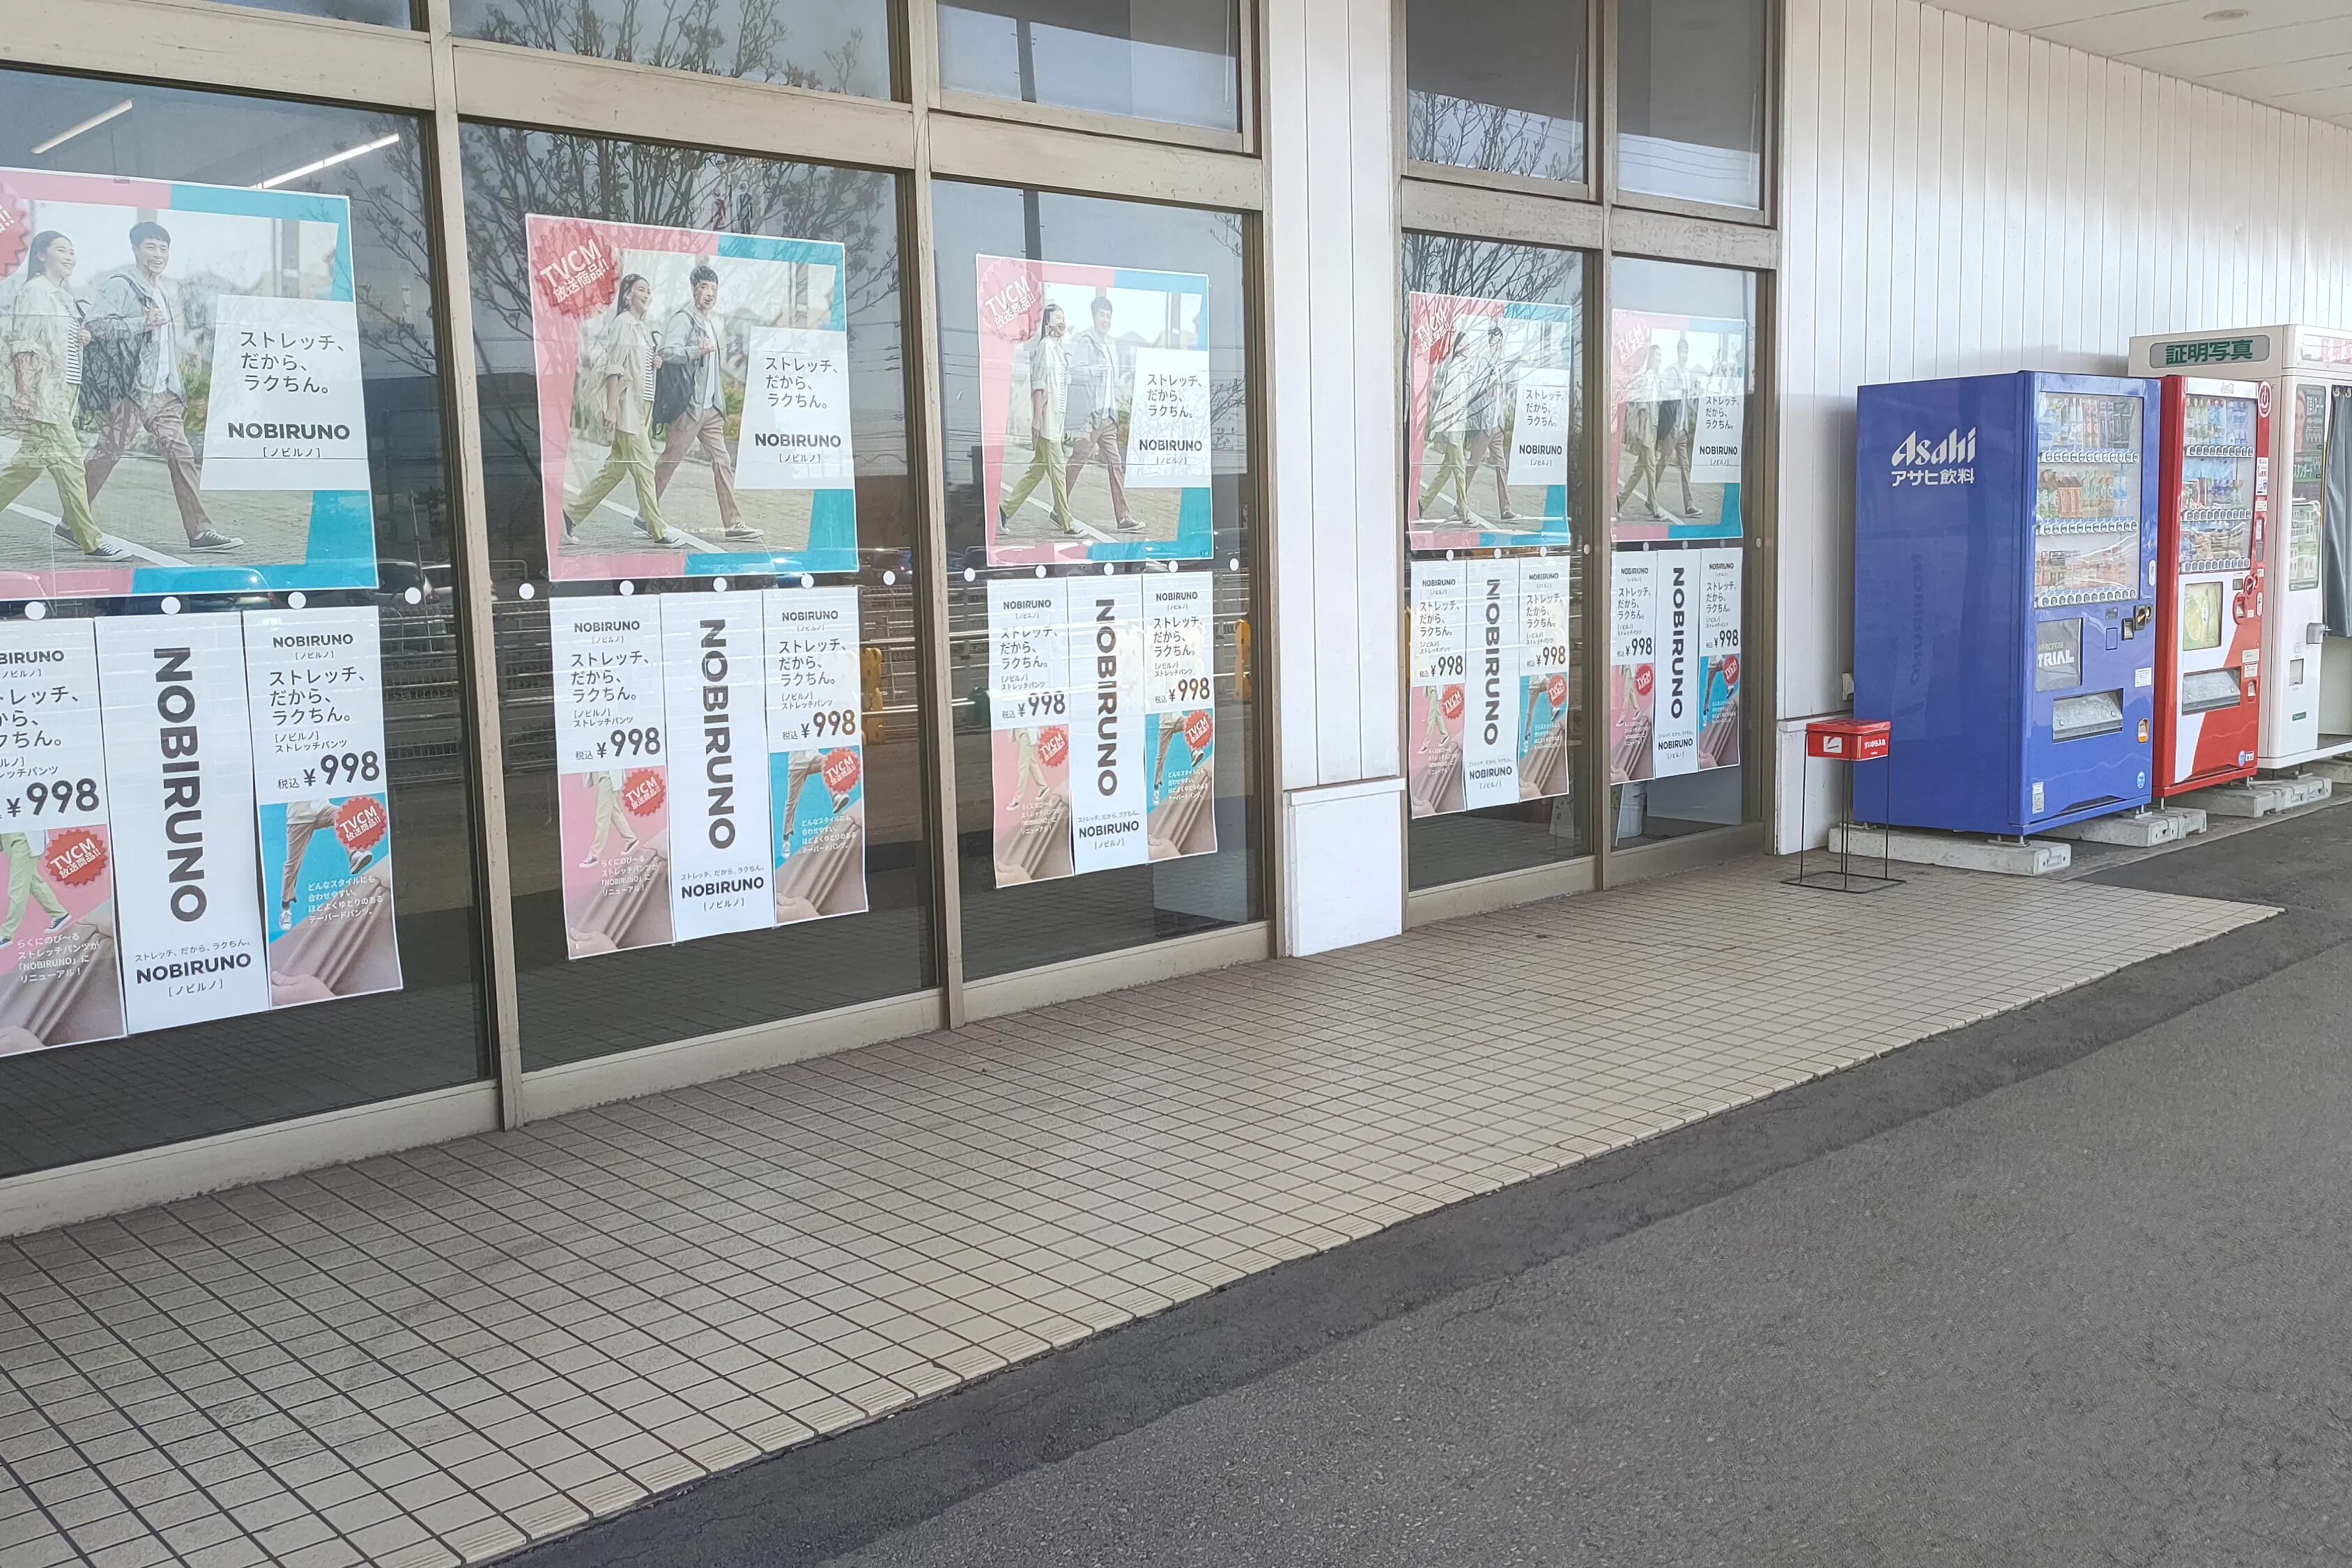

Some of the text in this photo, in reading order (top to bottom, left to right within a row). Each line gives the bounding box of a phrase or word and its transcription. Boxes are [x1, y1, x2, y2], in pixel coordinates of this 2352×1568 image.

[540, 239, 601, 287] TVCM
[985, 275, 1031, 316] TVCM
[241, 332, 344, 351] ストレッチ、
[2166, 339, 2252, 364] 証明写真
[241, 353, 307, 371] だから、
[766, 357, 838, 373] ストレッチ、
[245, 375, 328, 394] ラクちん。
[766, 375, 812, 390] だから、
[1148, 374, 1201, 387] ストレッチ、
[768, 393, 827, 409] ラクちん。
[1148, 389, 1182, 402] だから、
[1148, 405, 1192, 418] ラクちん。
[1526, 402, 1551, 413] だから、
[1706, 408, 1727, 417] だから、
[1528, 415, 1557, 427] ラクちん。
[1706, 420, 1733, 429] ラクちん。
[228, 423, 350, 440] NOBIRUNO
[755, 433, 840, 447] NOBIRUNO
[1139, 439, 1202, 451] NOBIRUNO
[1519, 445, 1562, 455] NOBIRUNO
[1700, 446, 1737, 455] NOBIRUNO
[1891, 426, 1976, 466] Asahi
[1891, 468, 1974, 486] アサヒ飲料
[1422, 579, 1455, 587] NOBIRUNO
[1004, 599, 1051, 610] NOBIRUNO
[1156, 592, 1198, 601] NOBIRUNO
[1420, 600, 1459, 611] ストレッチ、
[782, 610, 838, 622] NOBIRUNO
[1153, 616, 1202, 629] ストレッチ、
[574, 621, 640, 632] NOBIRUNO
[1420, 626, 1452, 637] ラクちん。
[273, 633, 353, 648] NOBIRUNO
[779, 638, 846, 654] ストレッチ、
[1153, 631, 1185, 644] だから、
[1671, 567, 1684, 718] NOBIRUNO
[1714, 629, 1738, 647] ¥998
[1000, 642, 1036, 654] だから、
[1154, 645, 1195, 657] ラクちん。
[1626, 637, 1652, 656] ¥998
[571, 650, 649, 666] ストレッチ、
[779, 656, 822, 670] だから、
[1002, 656, 1047, 670] ラクちん。
[1484, 579, 1500, 745] NOBIRUNO
[1536, 645, 1566, 667] ¥998
[2038, 650, 2074, 668] TRIAL
[1431, 655, 1463, 677] ¥998
[270, 666, 364, 686] ストレッチ、
[571, 670, 620, 686] だから、
[781, 671, 835, 687] ラクちん。
[0, 686, 78, 705] レッチ、
[270, 689, 330, 707] だから、
[573, 686, 636, 703] ラクちん。
[1096, 599, 1116, 796] NOBIRUNO
[1169, 677, 1210, 702] ¥998
[1017, 691, 1065, 717] ¥998
[272, 707, 350, 725] ラクちん。
[574, 717, 633, 728] ストレッチパンツ
[801, 709, 856, 738] ¥998
[700, 620, 735, 849] NOBIRUNO
[1187, 716, 1208, 737] TVCM
[275, 739, 347, 753] ストレッチパンツ
[575, 728, 661, 760] 税込 ¥998
[1040, 733, 1063, 755] TVCM
[1658, 739, 1693, 751] NOBIRUNO
[278, 751, 380, 789] 税込 ¥998
[825, 755, 853, 779] TVCM
[1470, 767, 1512, 780] NOBIRUNO
[153, 647, 208, 922] NOBIRUNO
[626, 776, 658, 801] TVCM
[7, 778, 99, 817] ¥998
[339, 806, 377, 834] TVCM
[1079, 821, 1139, 838] NOBIRUNO
[50, 838, 96, 870] TVCM
[308, 876, 375, 891] どんなスタイルにも
[682, 876, 764, 899] NOBIRUNO
[309, 897, 383, 912] ほどよくゆとりのある
[18, 941, 99, 960] ストレッチパンツが
[135, 939, 250, 962] ストレッチ、だから、ラクちん。
[137, 953, 251, 983] NOBIRUNO
